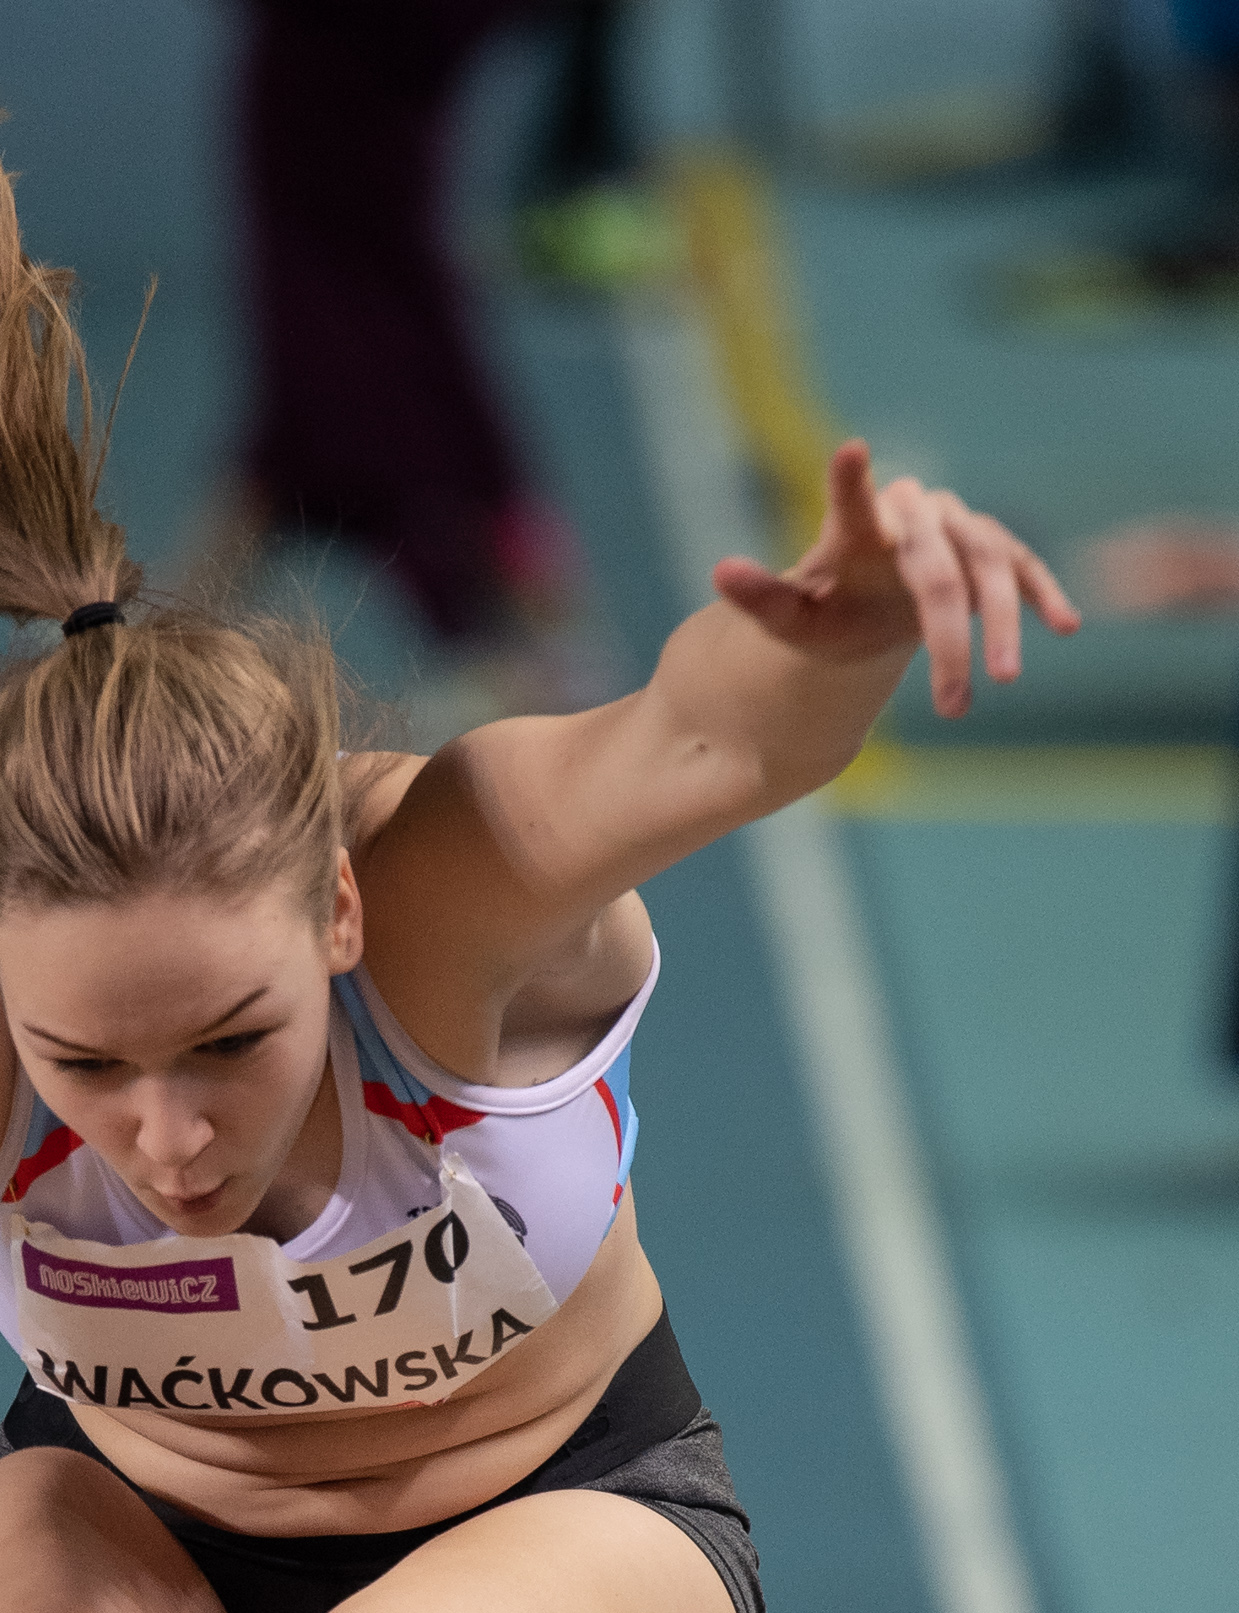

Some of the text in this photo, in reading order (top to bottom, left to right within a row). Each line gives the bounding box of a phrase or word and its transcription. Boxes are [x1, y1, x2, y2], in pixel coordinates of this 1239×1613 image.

[38, 1263, 221, 1305] noskiewicz
[287, 1209, 471, 1332] 170
[35, 1308, 536, 1411] WAĆKOWSKA
